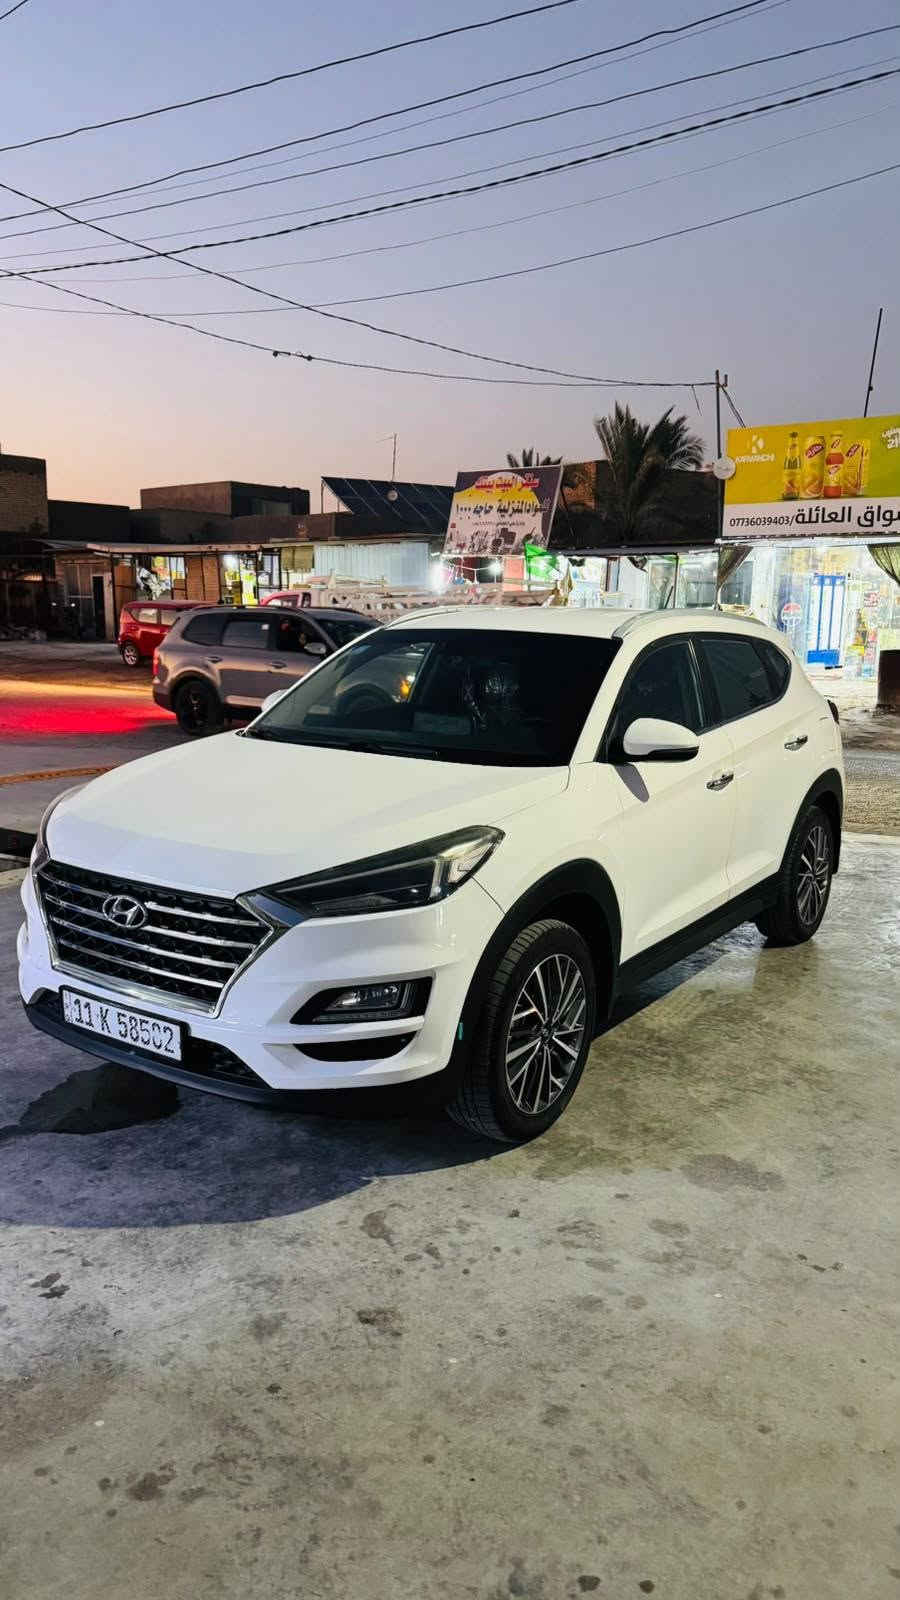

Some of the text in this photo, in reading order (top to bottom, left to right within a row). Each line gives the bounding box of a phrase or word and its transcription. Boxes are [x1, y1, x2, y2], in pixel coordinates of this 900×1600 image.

[857, 504, 900, 527] واق
[74, 999, 94, 1028] 11
[100, 1007, 111, 1034] K
[117, 1012, 174, 1053] 58502
